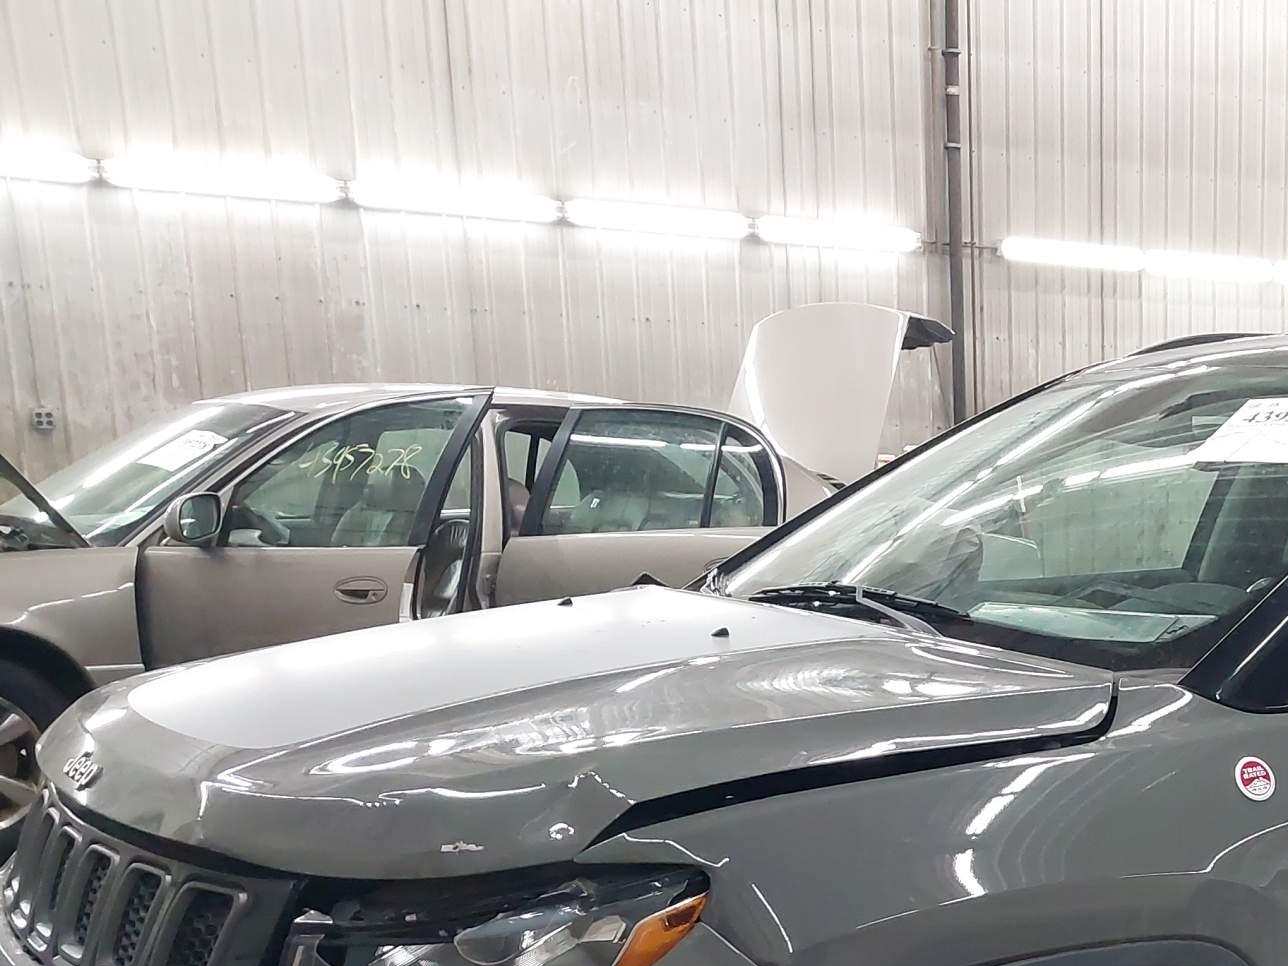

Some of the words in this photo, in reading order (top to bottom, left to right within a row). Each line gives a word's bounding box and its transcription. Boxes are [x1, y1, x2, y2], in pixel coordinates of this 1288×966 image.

[63, 752, 99, 791] Jeep
[1242, 765, 1265, 775] TRAIL
[1243, 770, 1267, 780] RATED
